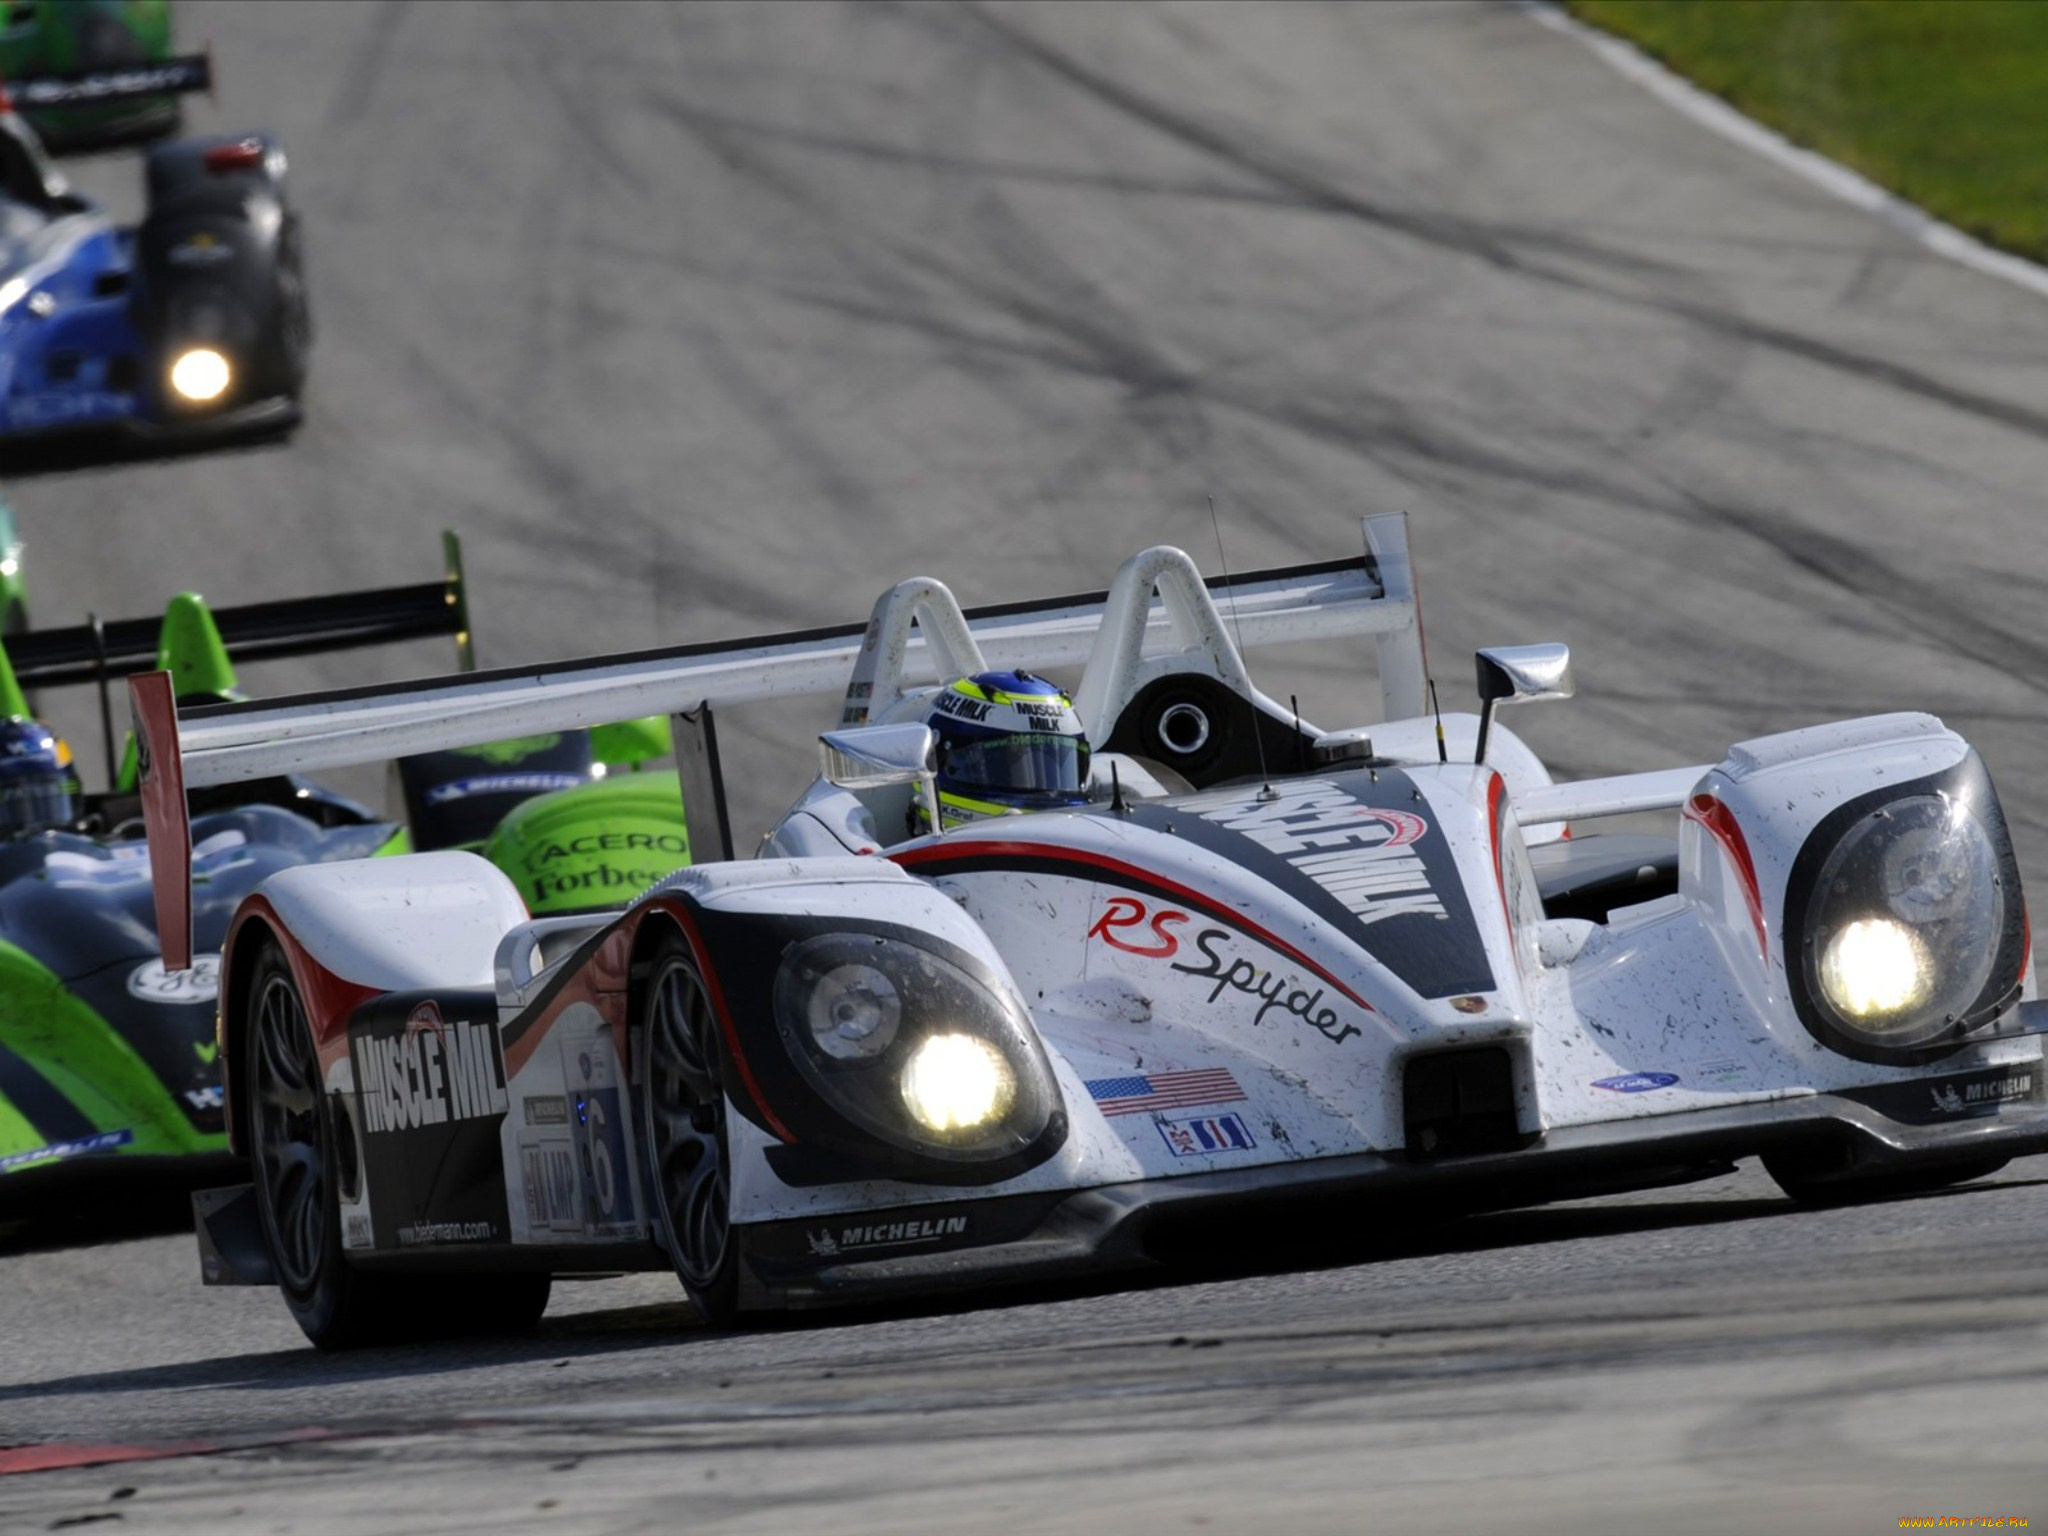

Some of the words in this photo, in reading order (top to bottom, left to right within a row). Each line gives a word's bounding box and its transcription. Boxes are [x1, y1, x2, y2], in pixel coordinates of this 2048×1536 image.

[955, 697, 992, 722] MILK
[1016, 702, 1064, 717] MUSCLE
[1028, 716, 1060, 731] MILK
[541, 833, 687, 863] ACERO
[1286, 841, 1446, 925] MILK
[1088, 897, 1190, 958] RS
[1170, 929, 1362, 1044] Spyder
[356, 1031, 448, 1133] MUSCLE
[1965, 1075, 2031, 1101] MICHELIN
[588, 1097, 615, 1215] 6
[841, 1216, 967, 1245] MICHELIN
